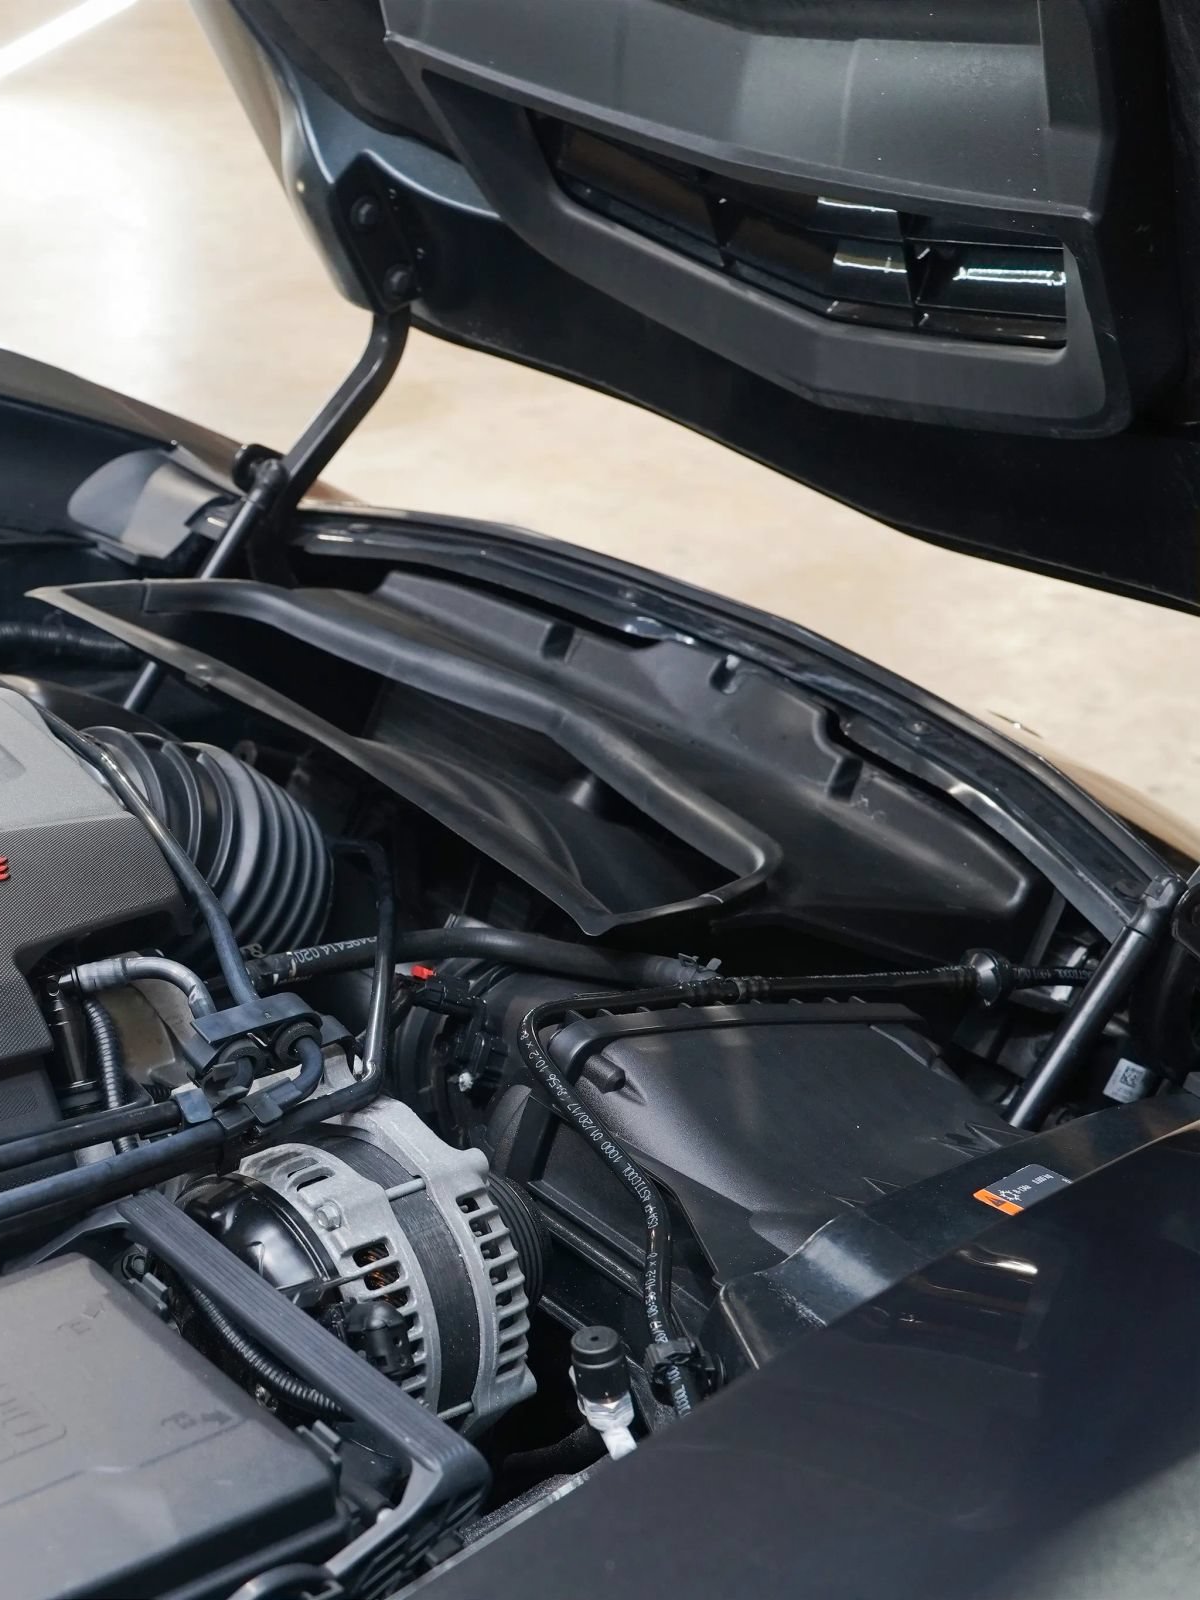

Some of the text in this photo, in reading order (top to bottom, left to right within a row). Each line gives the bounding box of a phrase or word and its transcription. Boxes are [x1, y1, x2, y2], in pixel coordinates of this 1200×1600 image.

[528, 1051, 550, 1073] 10.2
[566, 1102, 604, 1142] 01/20/17
[600, 1140, 623, 1163] 1000
